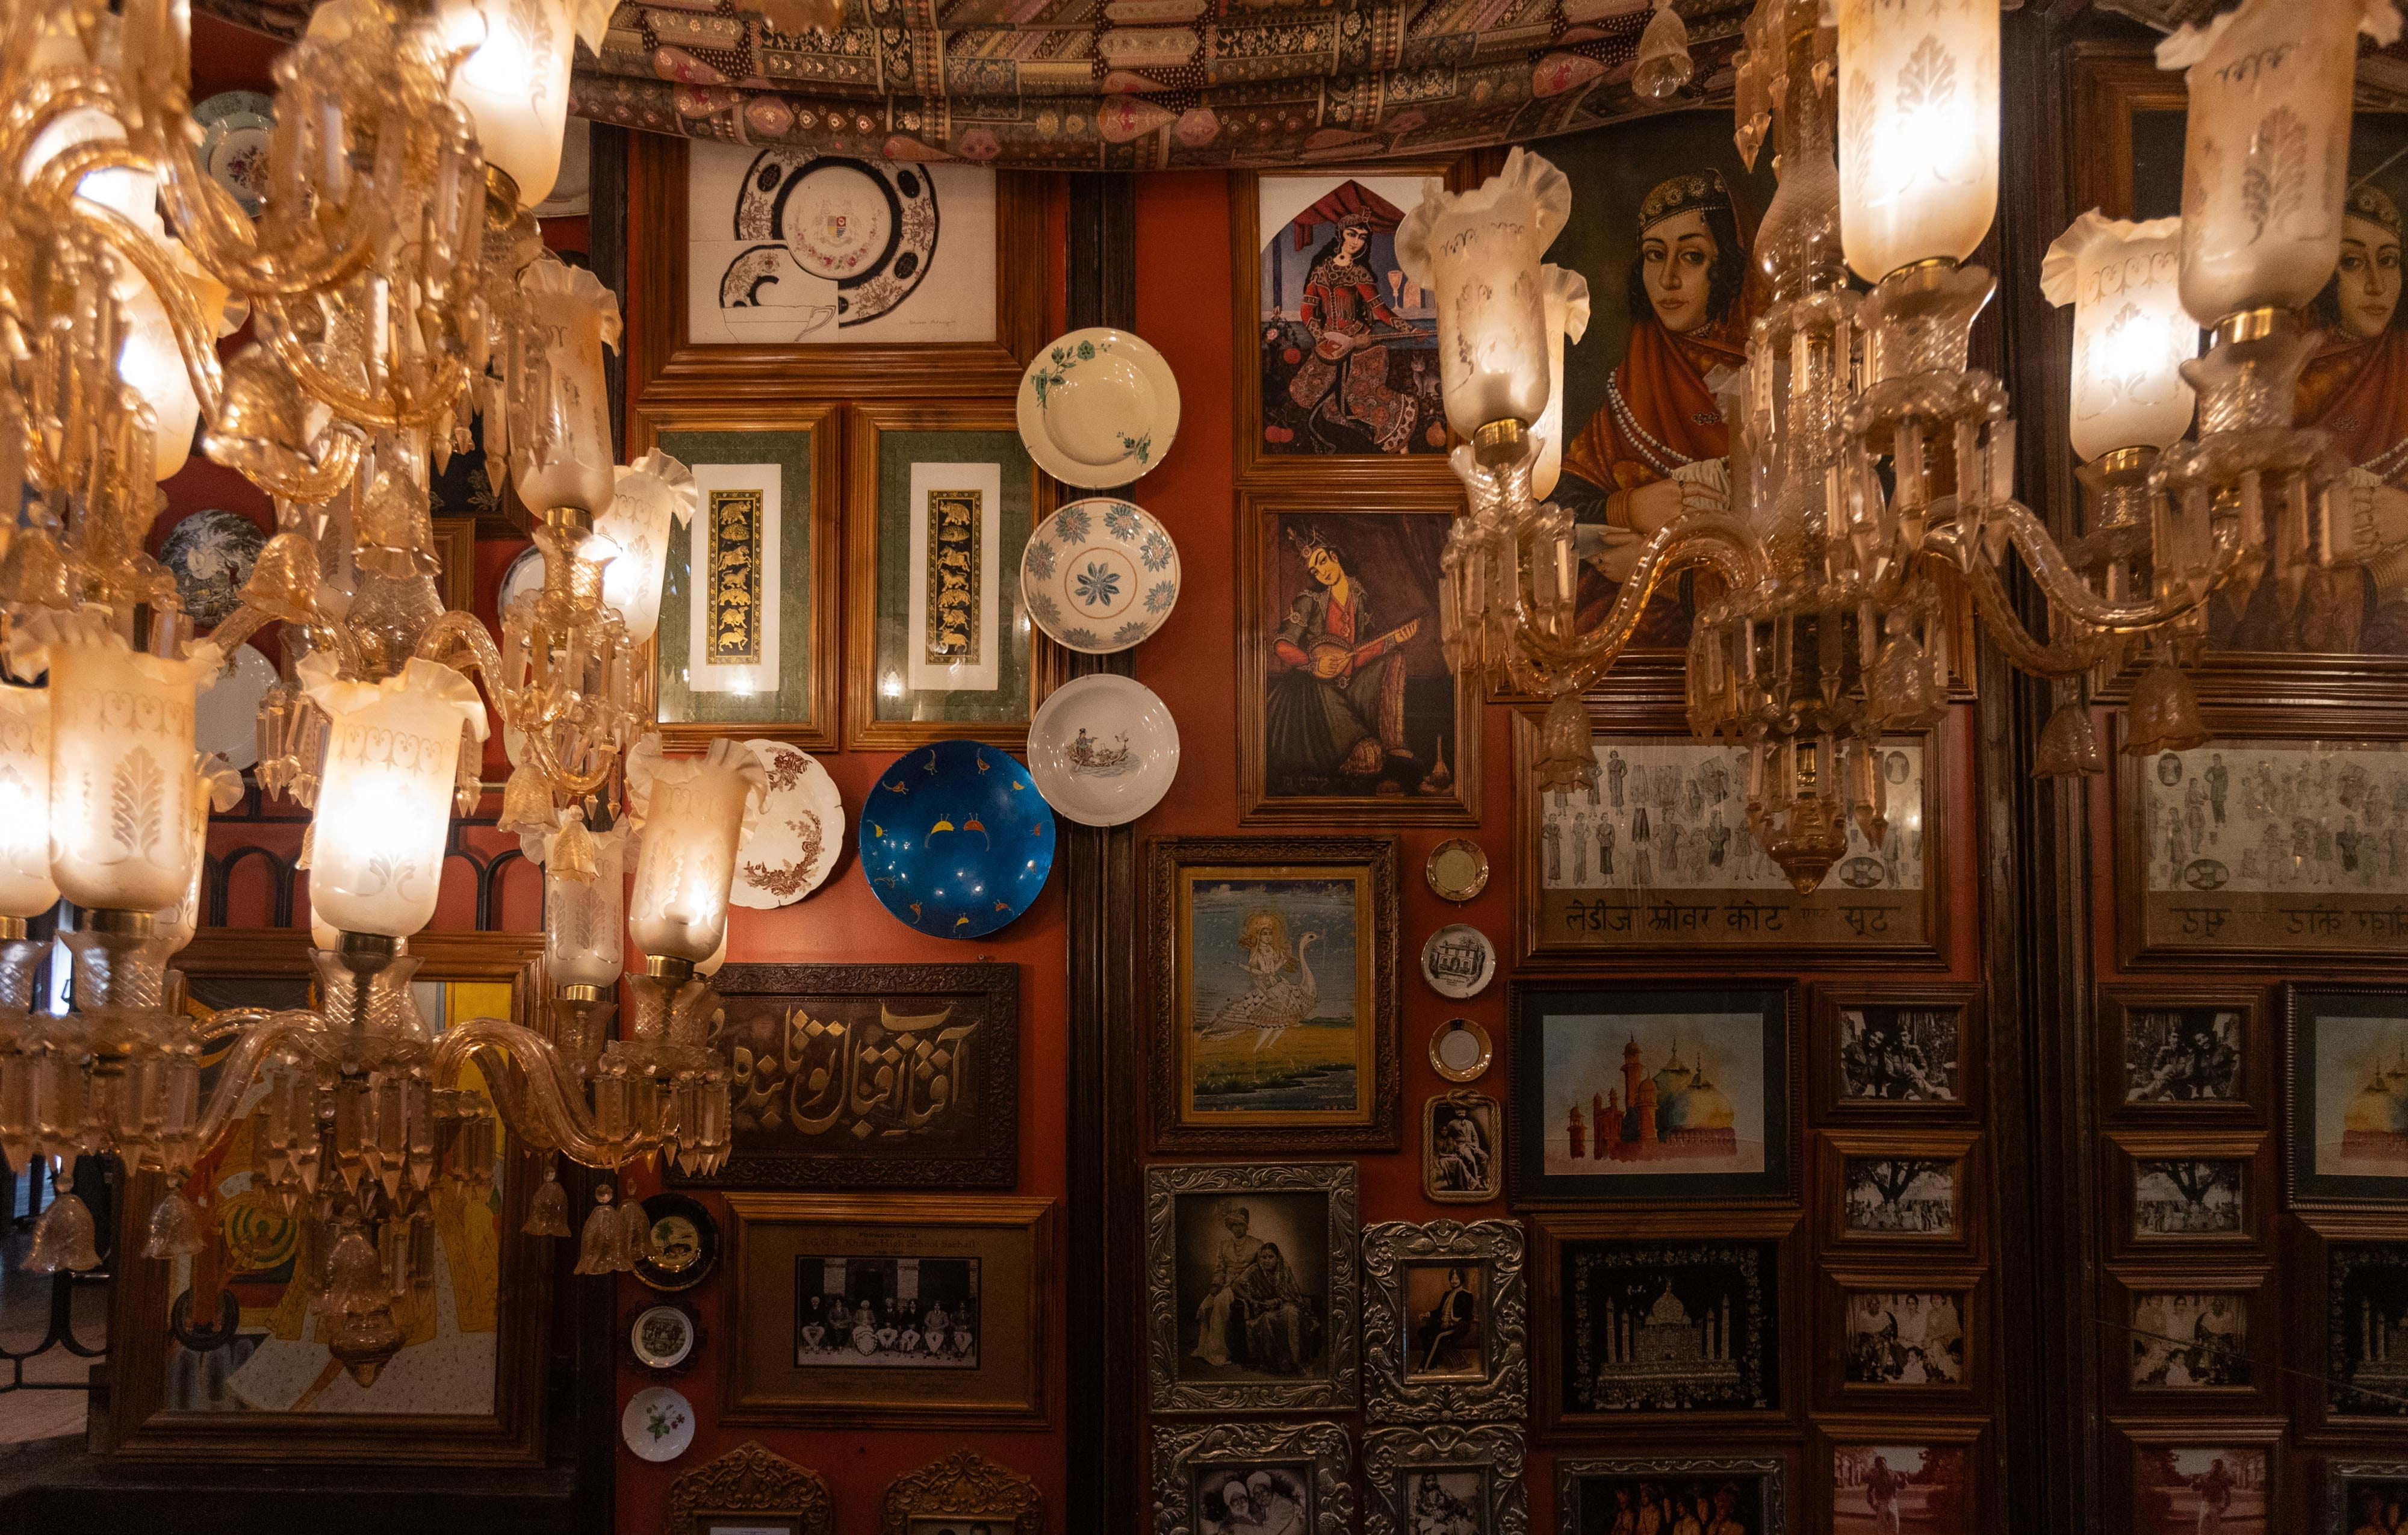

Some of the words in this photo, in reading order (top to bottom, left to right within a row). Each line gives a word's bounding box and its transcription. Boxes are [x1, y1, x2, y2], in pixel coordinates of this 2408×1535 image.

[1565, 898, 1641, 932] लेडीज
[1724, 899, 1789, 932] कोट
[1839, 904, 1901, 937] सूट
[880, 1239, 904, 1249] High
[907, 1239, 939, 1248] School
